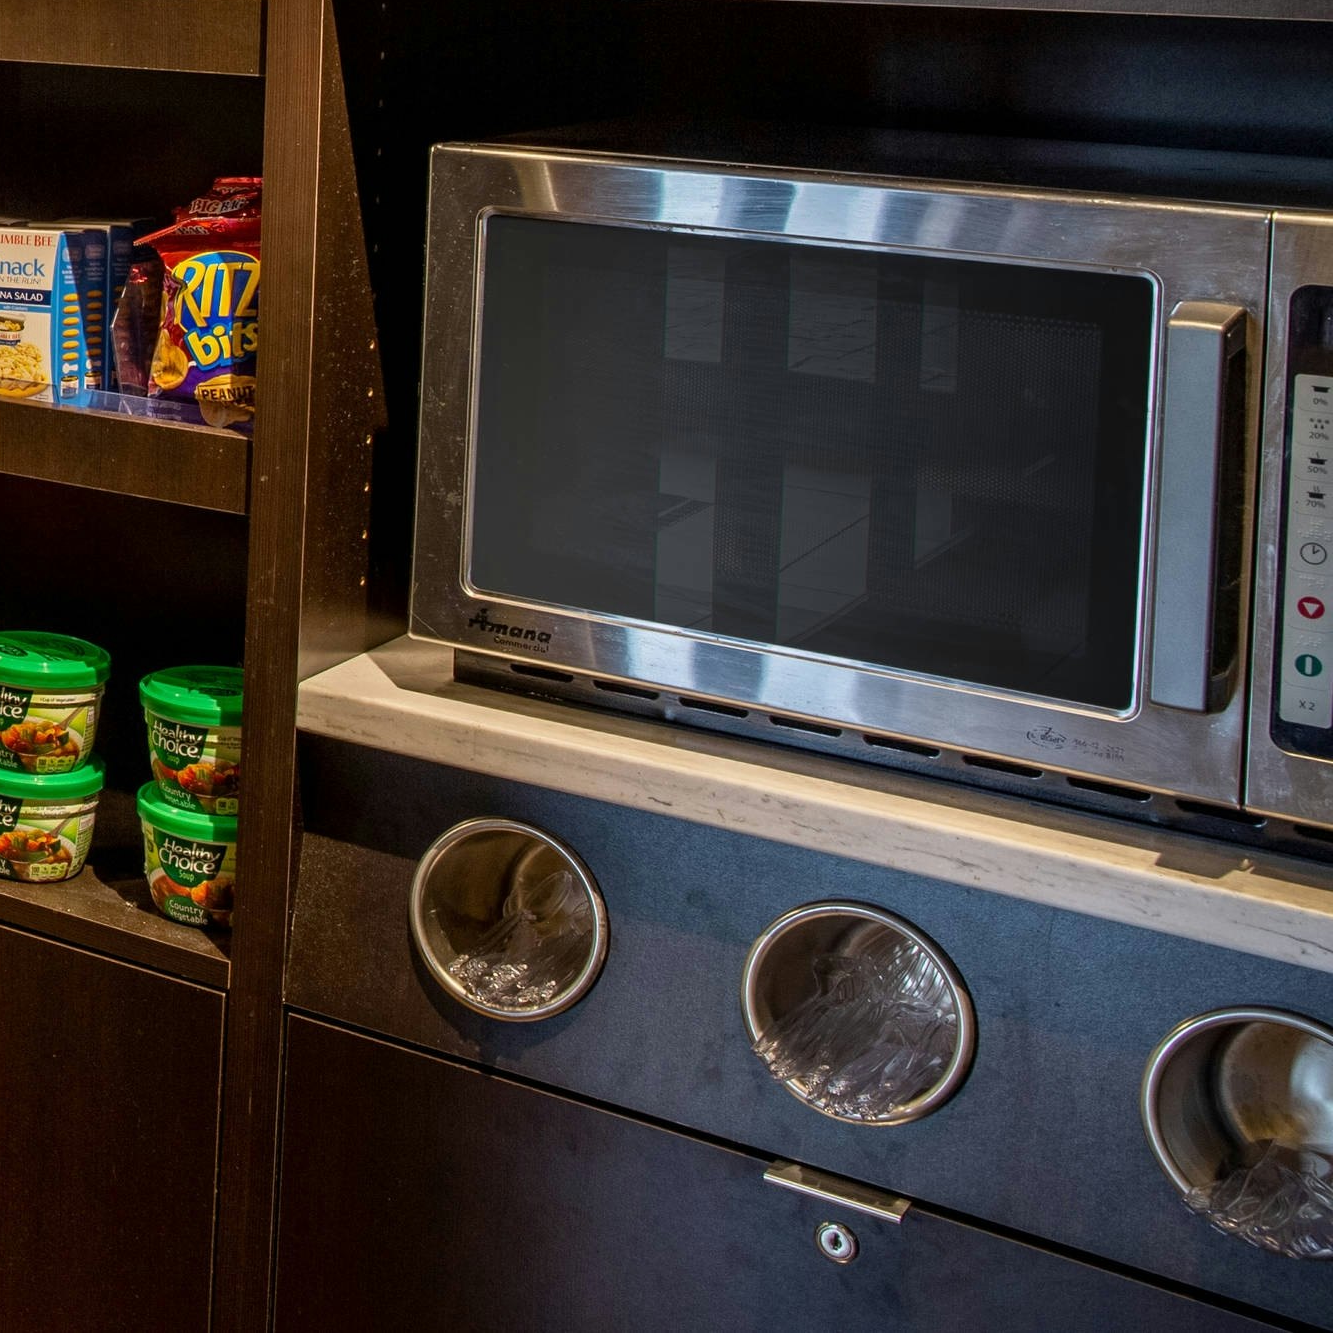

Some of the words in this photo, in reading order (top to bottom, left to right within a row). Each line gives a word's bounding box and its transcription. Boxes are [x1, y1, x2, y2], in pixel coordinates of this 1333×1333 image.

[33, 234, 53, 247] BEE
[14, 291, 44, 302] SALAD
[1313, 398, 1328, 406] 0%
[1308, 431, 1330, 440] 20%
[1305, 500, 1326, 509] 70%
[468, 608, 552, 643] Amana
[153, 720, 203, 744] Healthy
[152, 731, 201, 758] Choice
[164, 838, 221, 863] Healthy
[159, 847, 217, 875] Choice
[179, 869, 195, 882] Soup
[169, 899, 204, 916] Country
